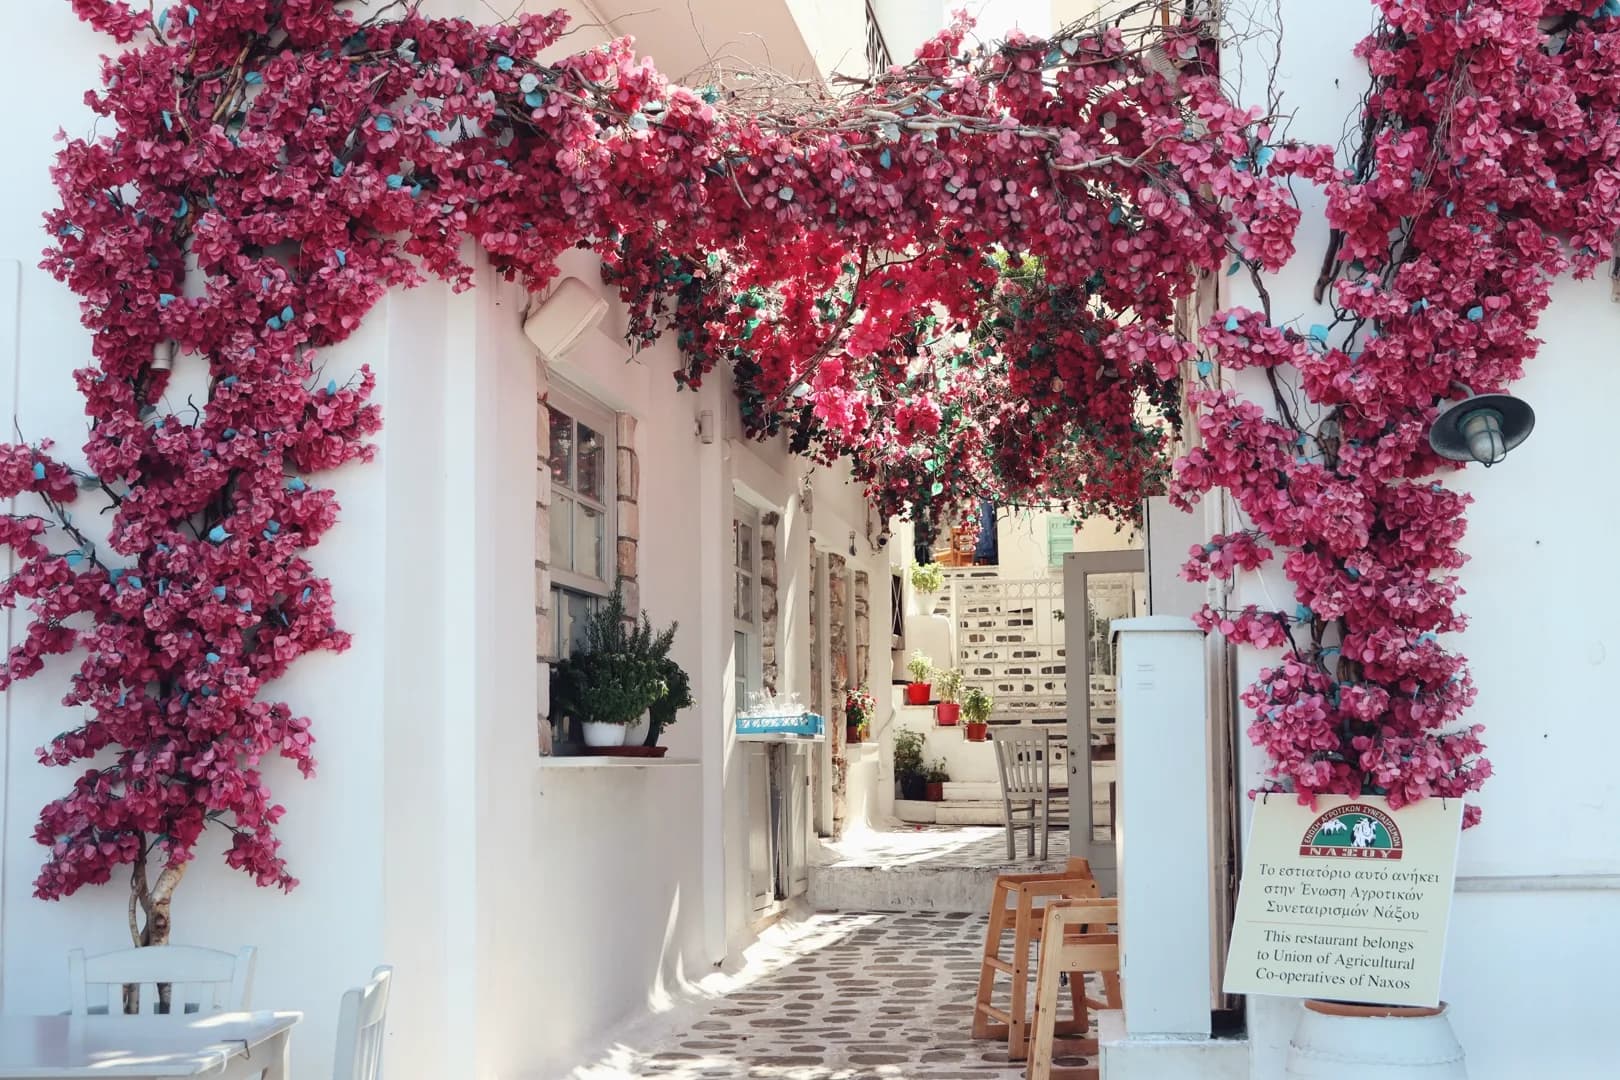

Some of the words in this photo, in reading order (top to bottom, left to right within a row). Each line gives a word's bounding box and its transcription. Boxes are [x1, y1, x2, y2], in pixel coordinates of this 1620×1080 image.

[1259, 864, 1275, 875] Το
[1279, 865, 1350, 880] εστιατόριο
[1354, 867, 1388, 880] αυτό
[1392, 869, 1439, 883] ανήκει
[1264, 885, 1295, 896] στην
[1301, 883, 1346, 899] Ένωση
[1350, 886, 1423, 901] Αγροτικών
[1266, 901, 1369, 917] Συνεταιρισμών
[1374, 904, 1419, 922] Νάξου
[1264, 930, 1291, 942] This
[1295, 933, 1358, 947] restaurant
[1362, 934, 1414, 951] belongs
[1257, 950, 1269, 961] to
[1273, 950, 1312, 963] Union
[1316, 953, 1332, 964] of
[1334, 955, 1415, 969] Agricultural
[1256, 968, 1345, 985] Co-operatives
[1350, 974, 1366, 986] of
[1368, 975, 1410, 990] Naxos
